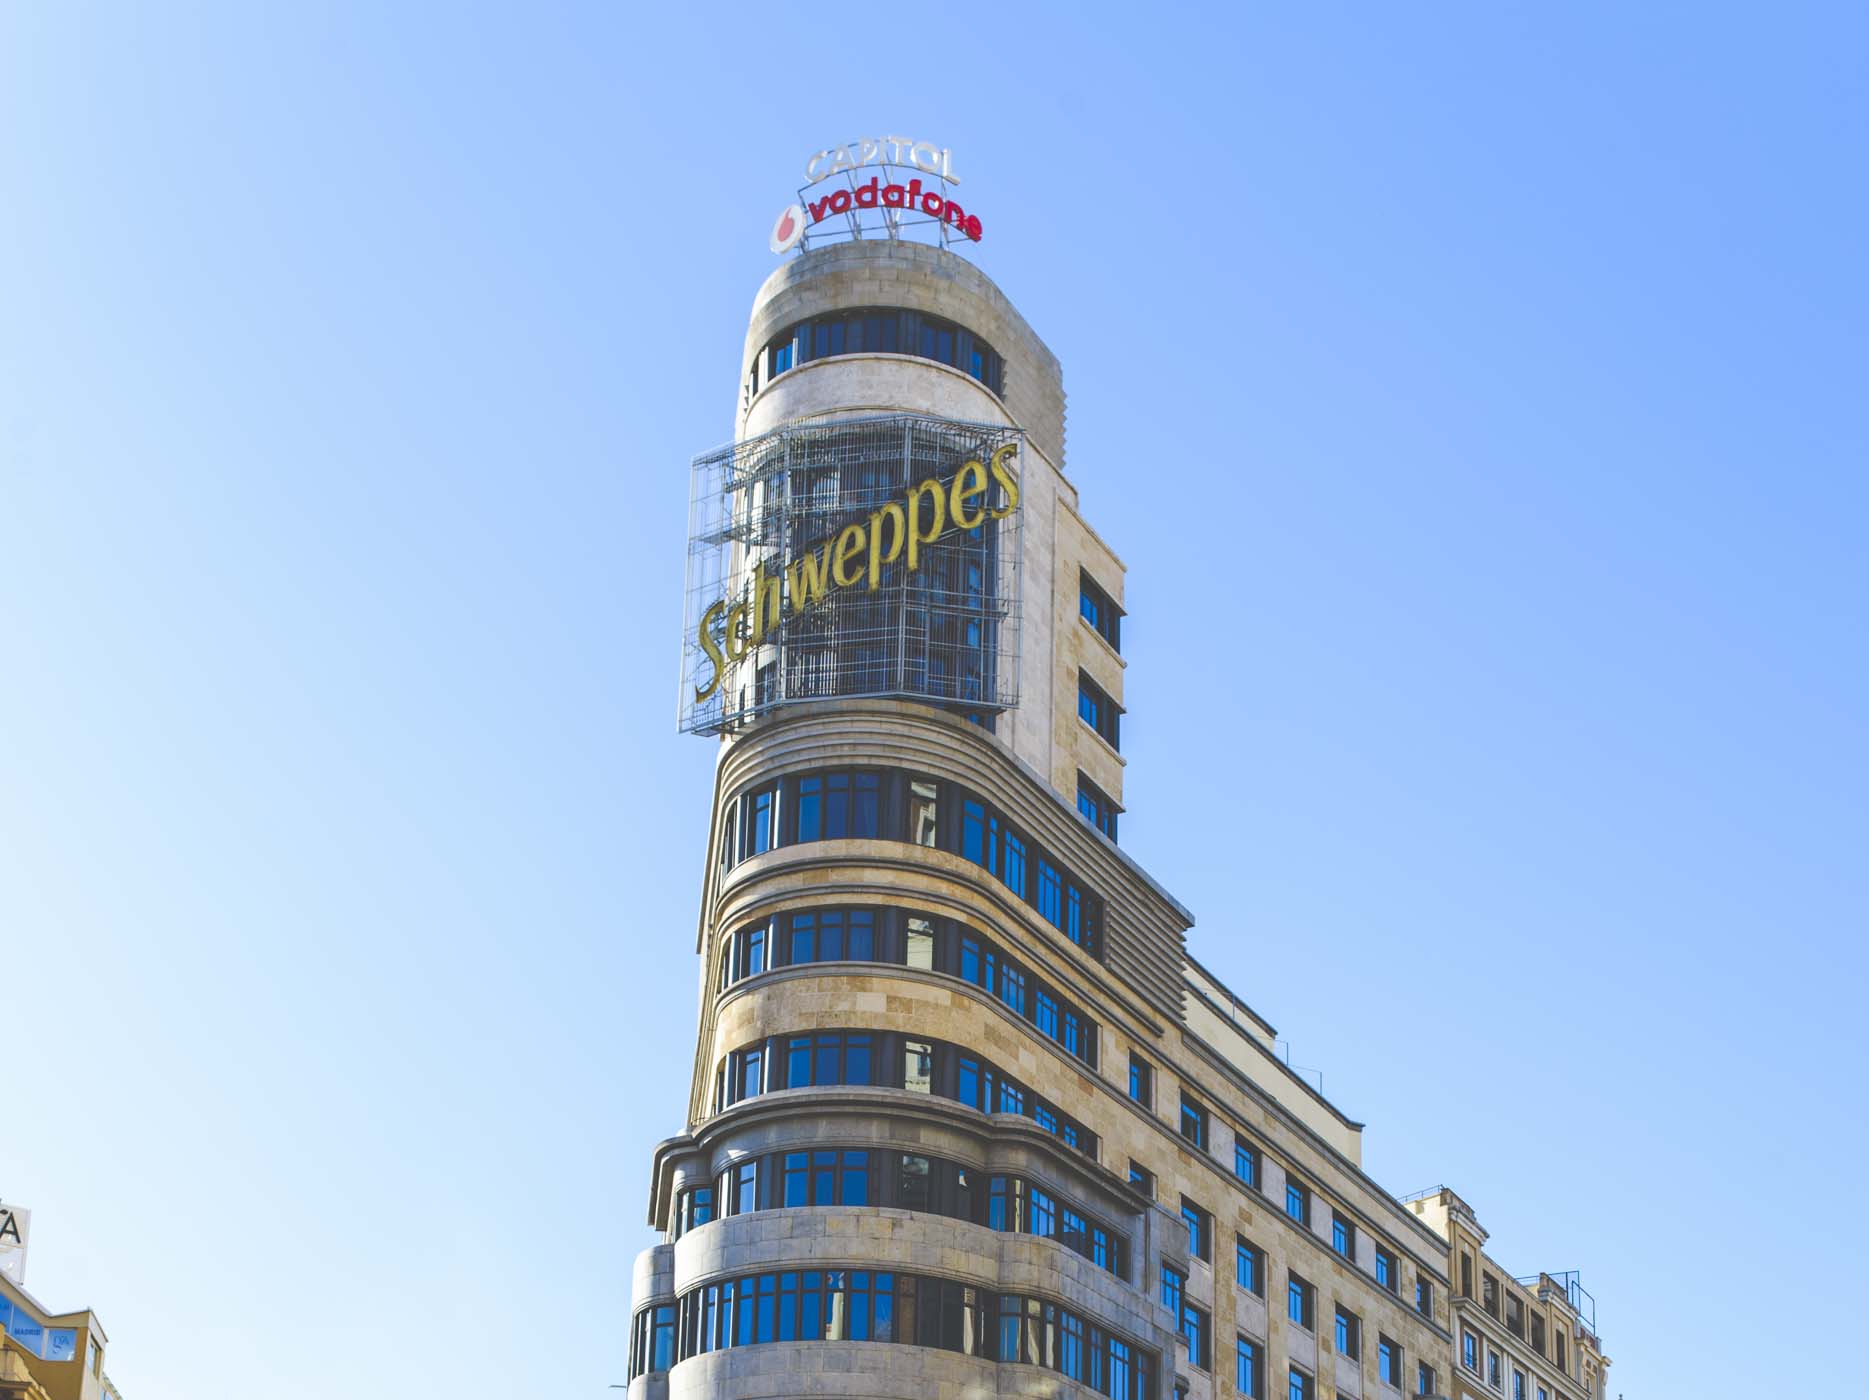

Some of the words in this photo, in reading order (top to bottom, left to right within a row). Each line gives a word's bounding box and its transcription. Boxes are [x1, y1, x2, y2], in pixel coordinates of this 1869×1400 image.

[805, 135, 960, 186] CAPITOL
[808, 176, 983, 243] vodafone
[695, 443, 1019, 704] Schweppes
